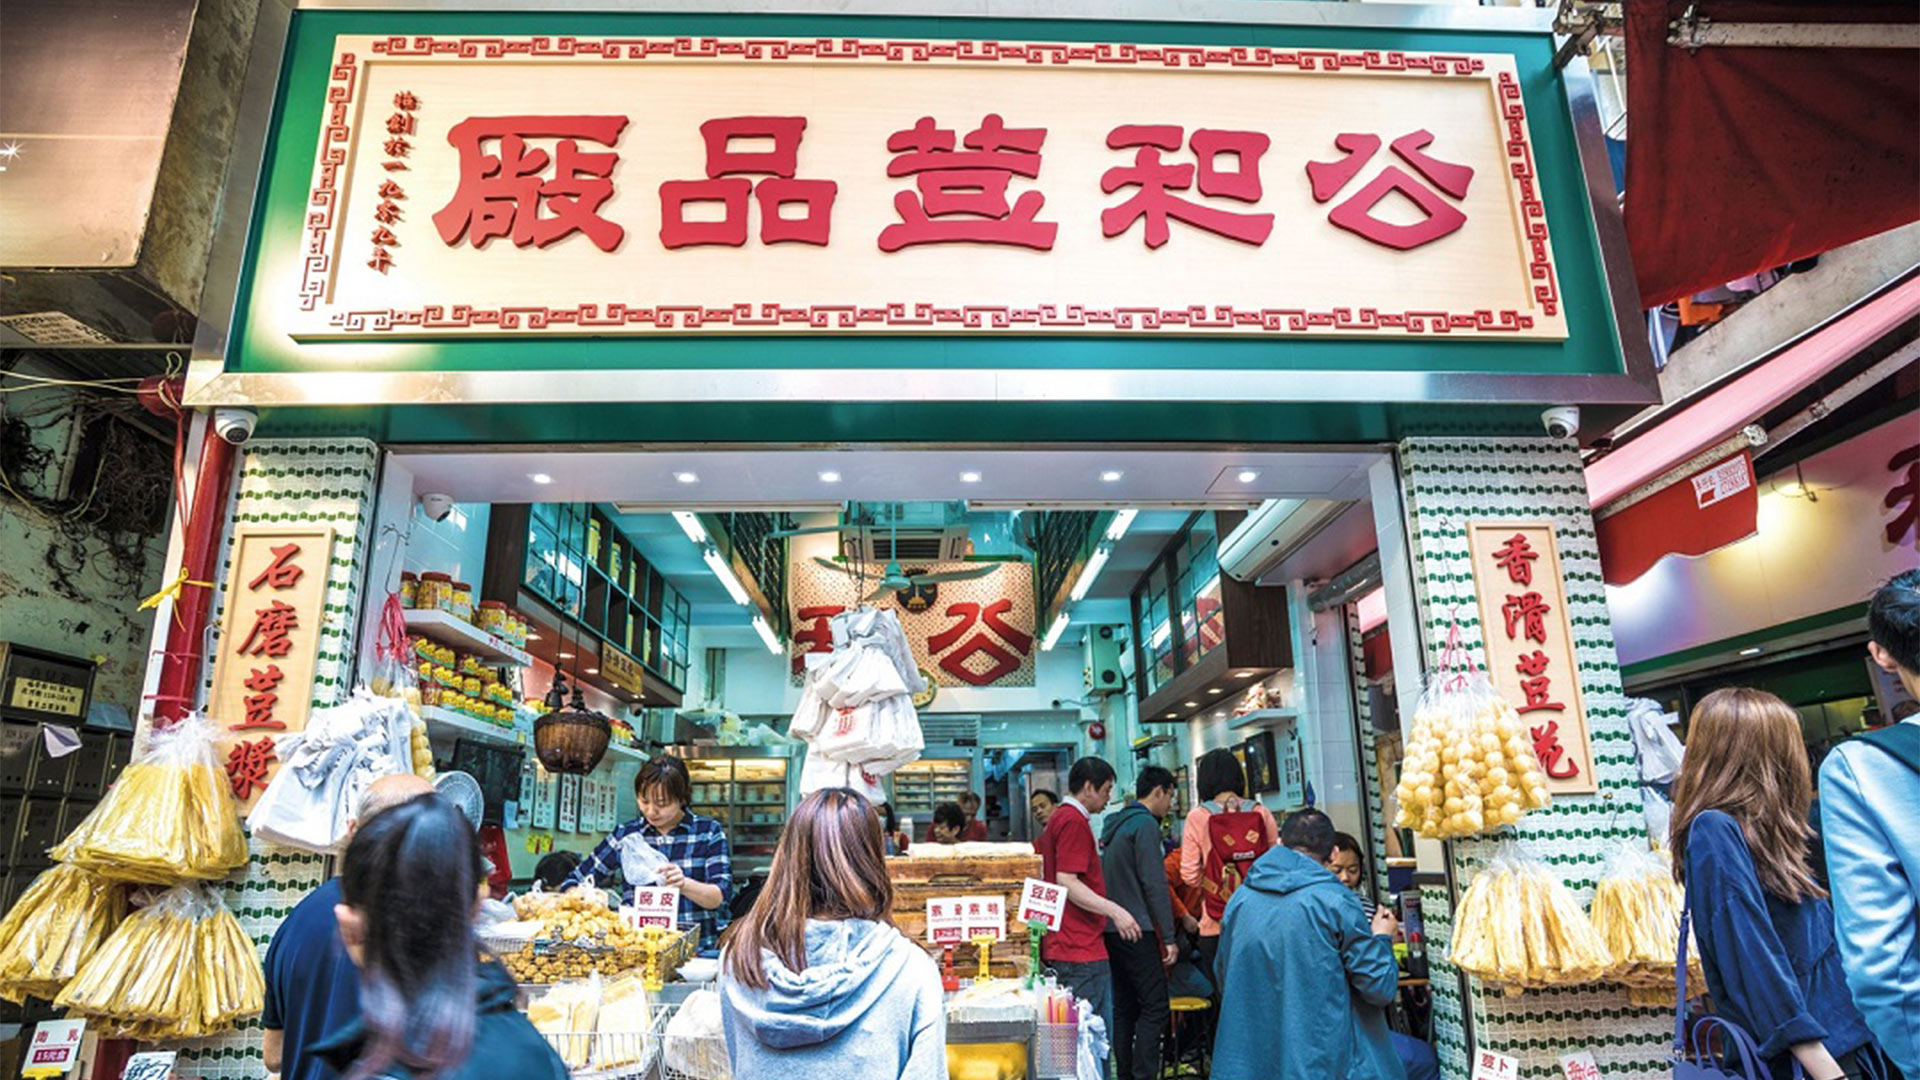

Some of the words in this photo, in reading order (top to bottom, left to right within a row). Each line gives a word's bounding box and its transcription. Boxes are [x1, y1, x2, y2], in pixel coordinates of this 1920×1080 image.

[227, 543, 304, 800] 石磨荳漿
[1492, 533, 1580, 779] 香滑荳花
[1030, 884, 1059, 903] 豆腐
